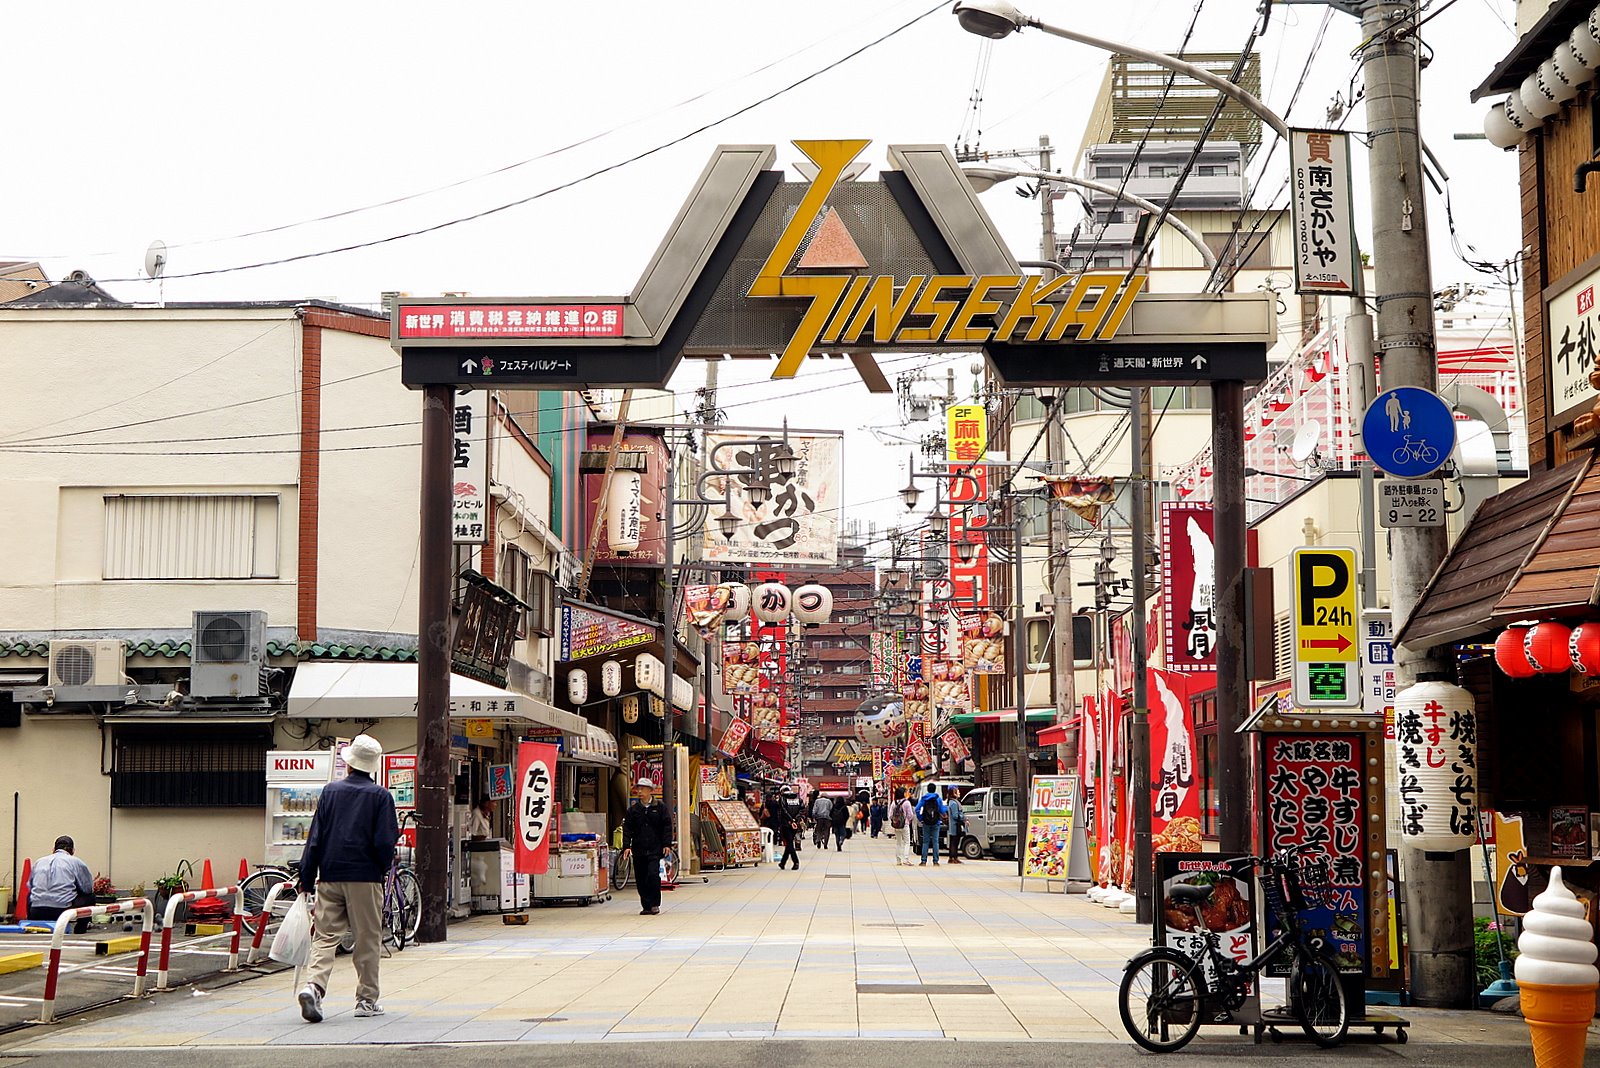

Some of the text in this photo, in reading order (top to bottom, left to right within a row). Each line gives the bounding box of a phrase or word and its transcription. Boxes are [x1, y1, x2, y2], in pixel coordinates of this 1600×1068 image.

[1306, 134, 1333, 163] 質
[1308, 166, 1337, 268] 南さかいや
[1305, 272, 1338, 282] 北へ150m
[405, 314, 444, 329] 新世界
[450, 310, 617, 326] 消費税完納推進の街
[1557, 315, 1600, 376] 千秋
[499, 359, 572, 371] フェスティバルゲート
[1113, 357, 1184, 369] 通天閣・新世界
[955, 408, 972, 418] 2F
[954, 420, 980, 461] 麻雀
[1384, 485, 1438, 496] 路外駐車場からの
[1391, 496, 1431, 507] 出入りを除く
[627, 477, 641, 540] ヤマハチ商店
[1299, 553, 1349, 626] P
[1316, 606, 1352, 626] 24h
[1182, 607, 1217, 657] 風月
[1309, 664, 1346, 700] 空
[1373, 675, 1381, 697] 平日
[1423, 699, 1447, 769] 牛すじ
[274, 758, 315, 770] KIRIN
[1274, 740, 1351, 761] 大阪名物
[1397, 709, 1428, 836] 焼きそば
[1449, 709, 1477, 836] 焼きそば
[525, 767, 550, 842] たばこ
[1151, 764, 1194, 818] 風月
[1329, 764, 1362, 886] 牛すじ煮
[1178, 861, 1232, 872] 新世界の味
